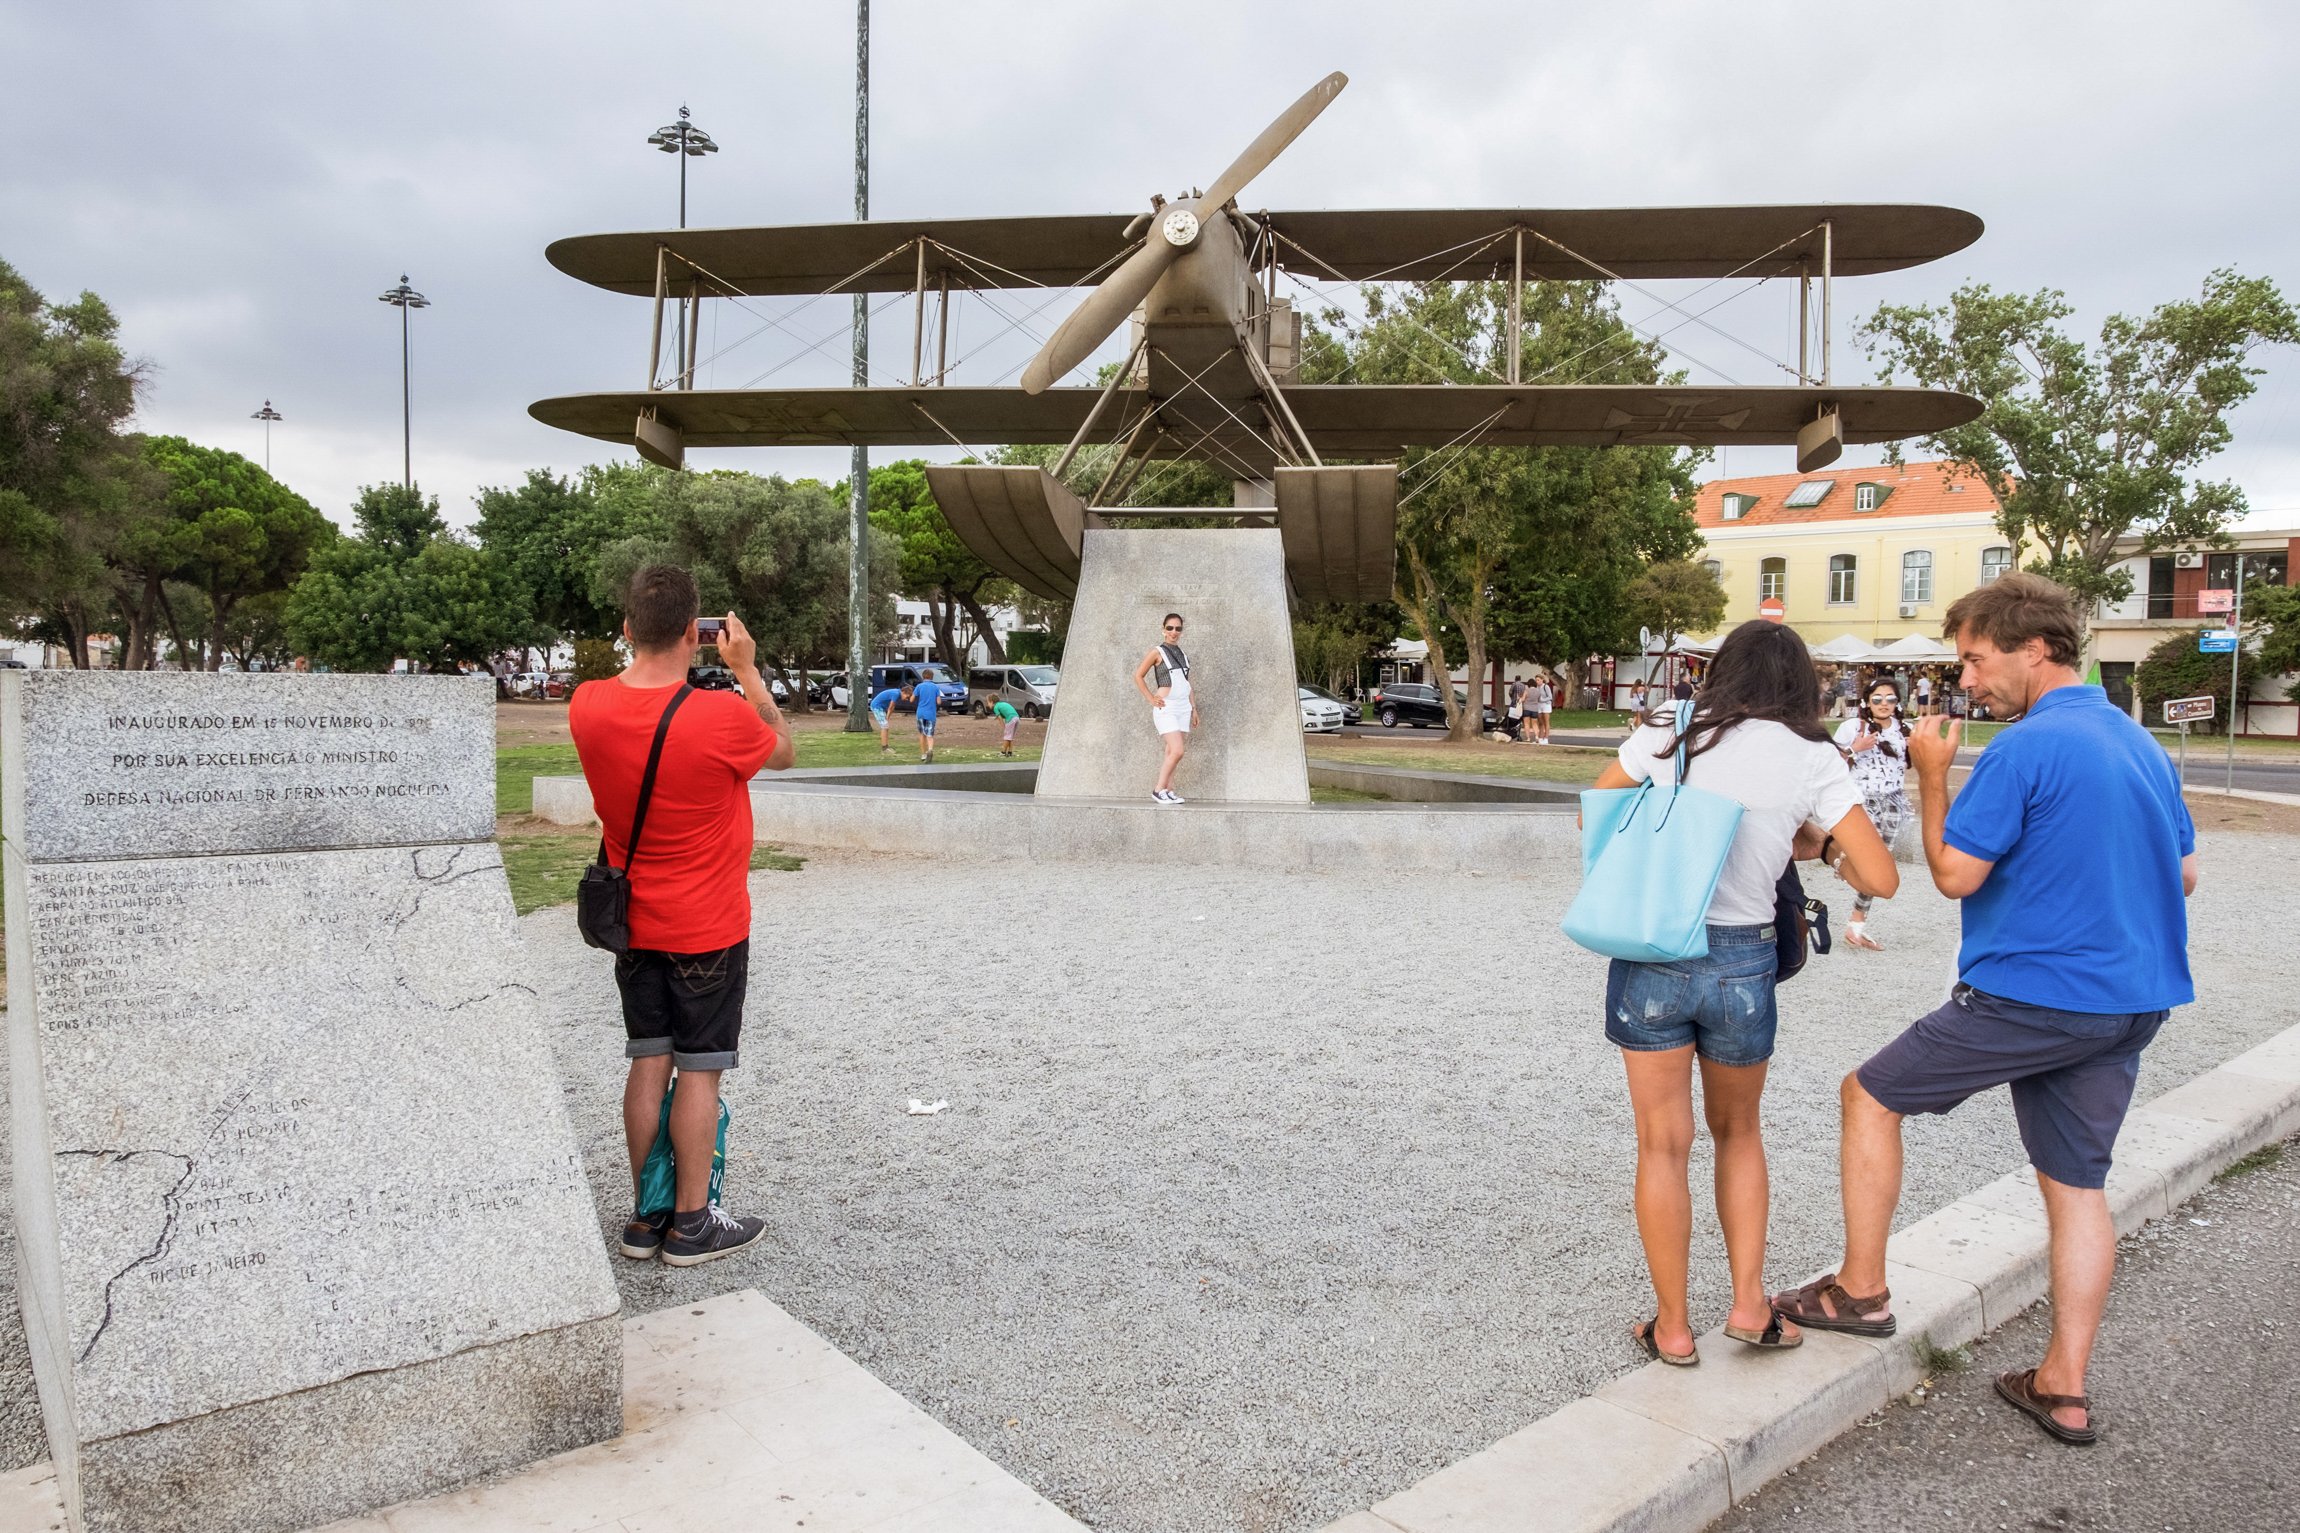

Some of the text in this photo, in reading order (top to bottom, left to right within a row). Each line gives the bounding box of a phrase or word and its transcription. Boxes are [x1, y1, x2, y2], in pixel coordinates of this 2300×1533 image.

[109, 715, 226, 729] INAUGURADO
[232, 716, 256, 729] EM
[284, 716, 373, 729] NOVEMBRO
[112, 754, 147, 767] POR
[154, 754, 189, 767] SUA
[196, 752, 298, 766] EXCELENCIA
[305, 752, 315, 764] O
[322, 750, 398, 764] MINISTRO
[84, 792, 151, 806] DEFESA
[159, 789, 244, 805] NACIONAL
[255, 788, 276, 801] DR
[285, 785, 369, 800] FERNANDO
